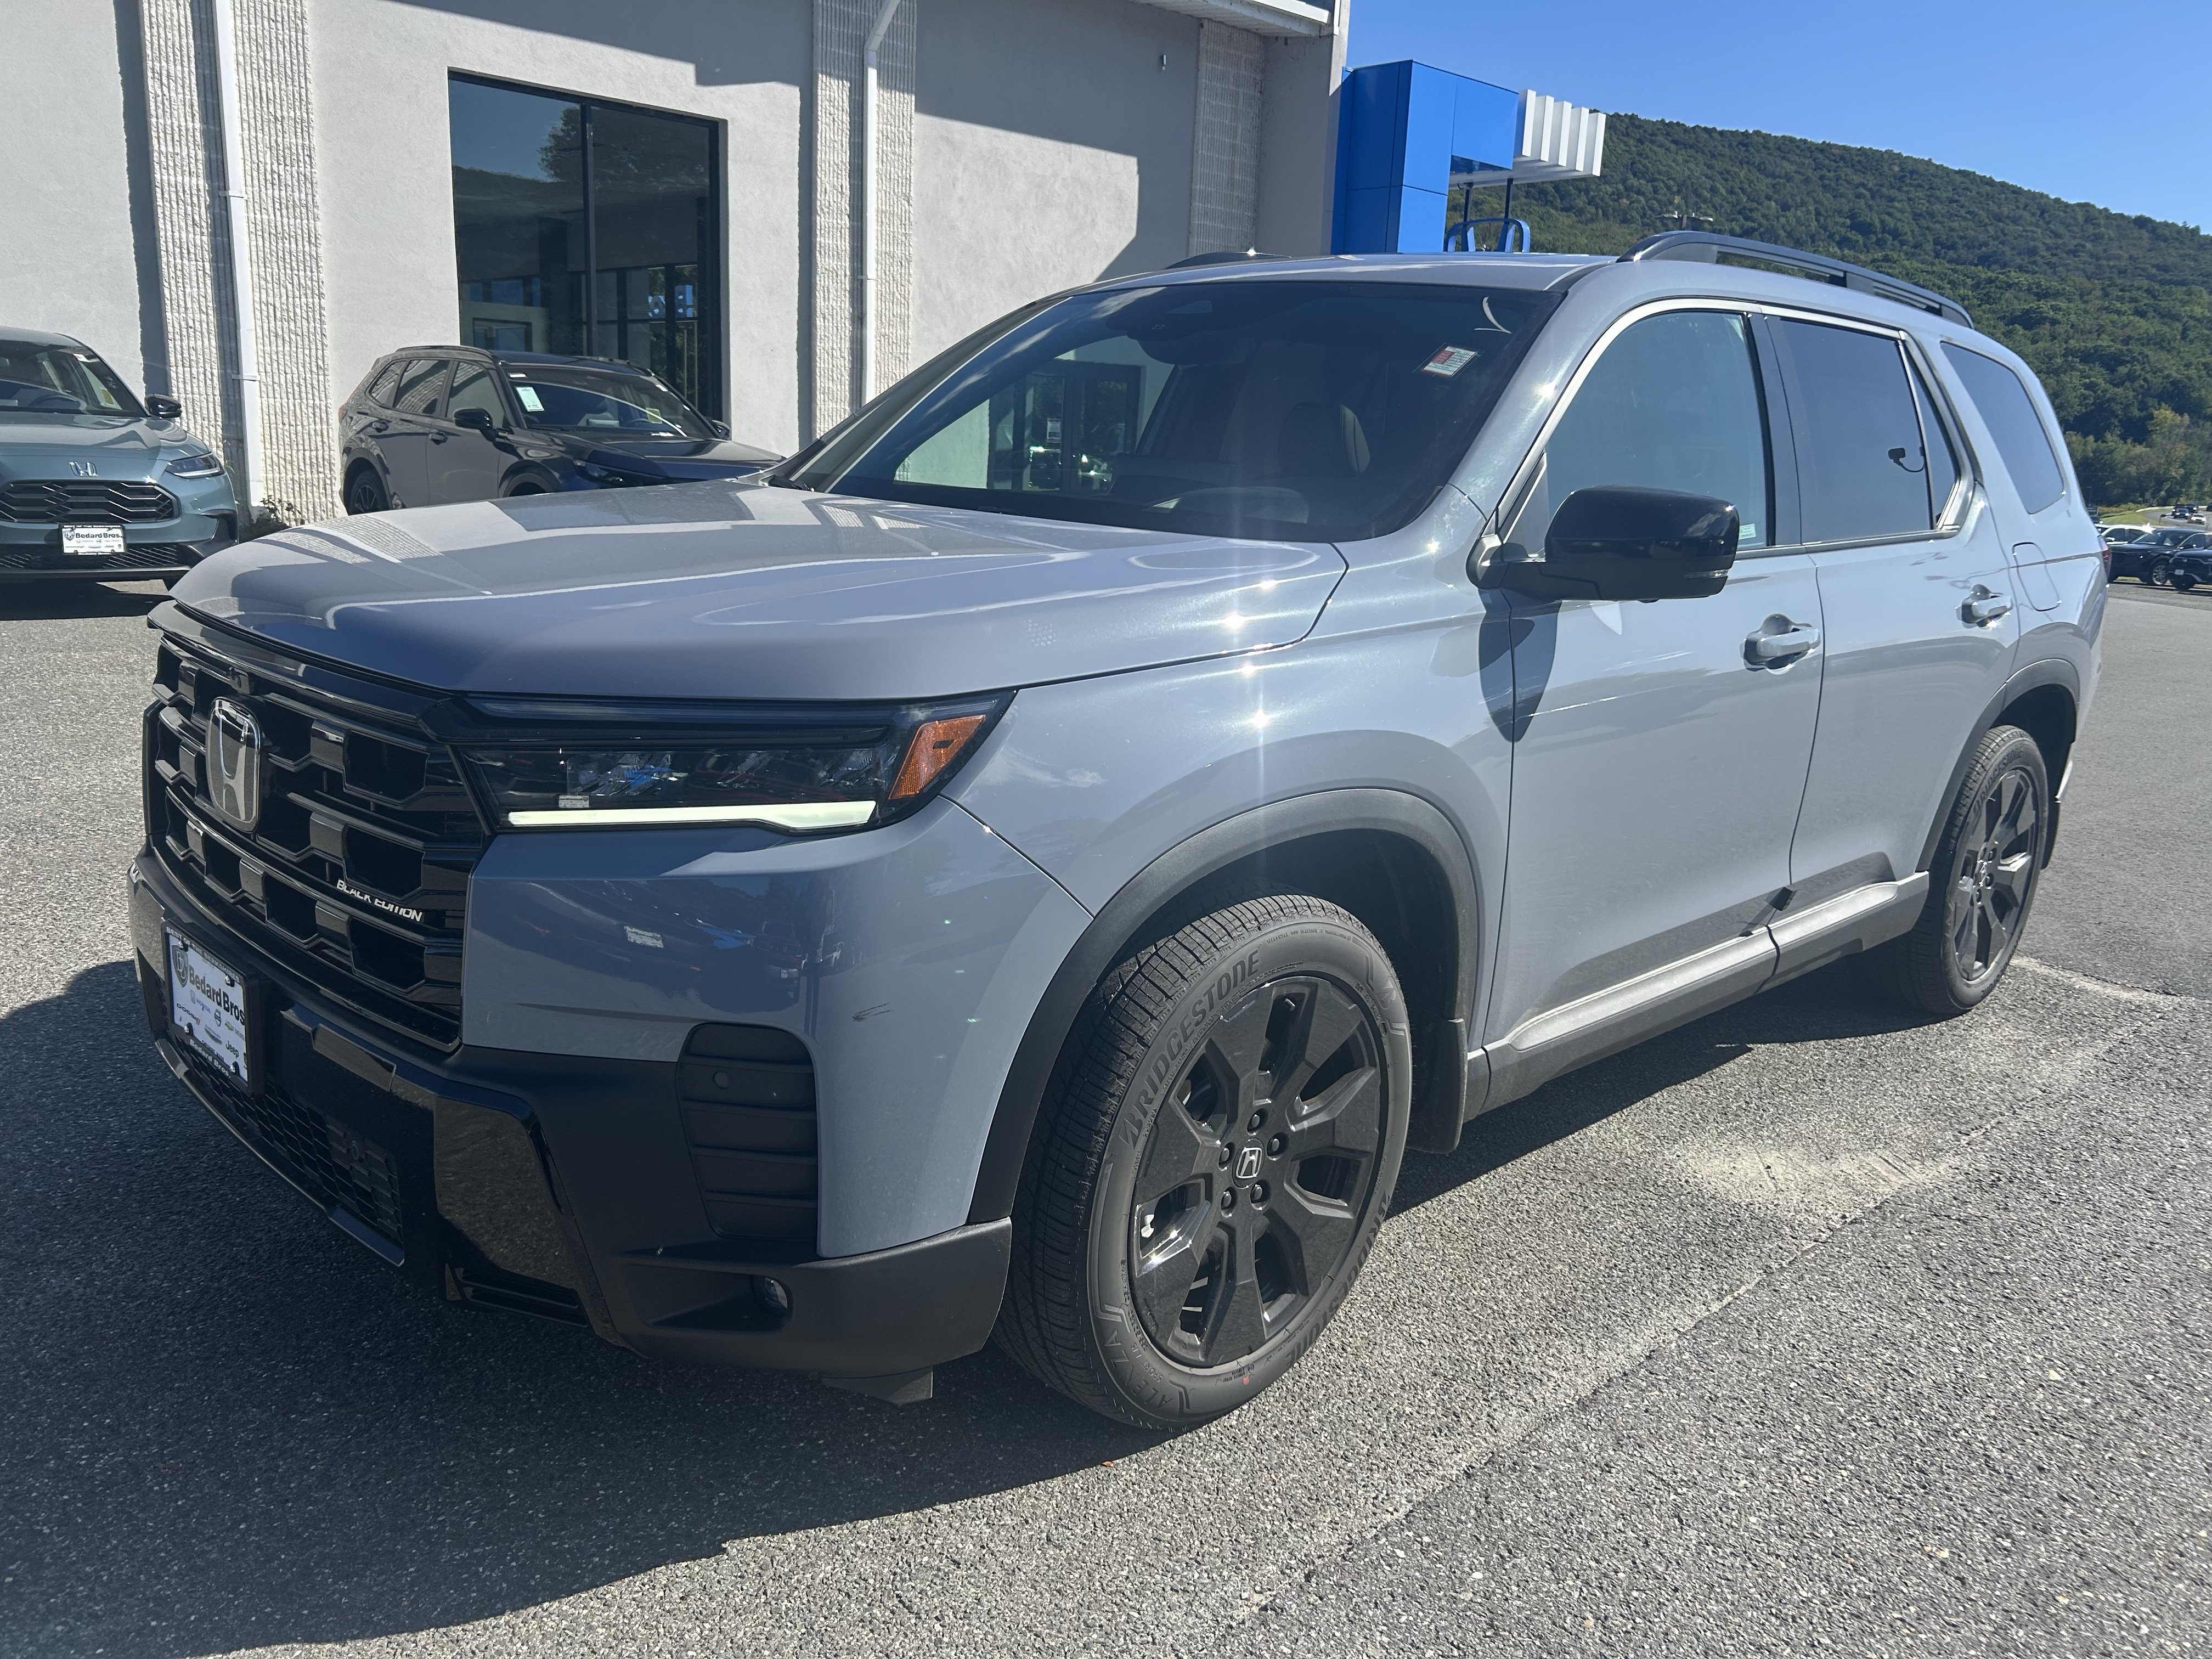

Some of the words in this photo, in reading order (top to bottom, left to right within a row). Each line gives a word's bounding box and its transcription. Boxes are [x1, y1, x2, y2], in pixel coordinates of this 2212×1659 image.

[336, 879, 372, 904] BLACK
[374, 898, 422, 922] EDITION
[166, 926, 182, 940] BEST
[189, 964, 222, 1008] Bedard
[190, 1039, 212, 1062] Bedard
[214, 1058, 232, 1079] Bros.
[225, 1040, 239, 1059] Jeep
[1119, 950, 1261, 1149] BRIDGESTONE
[1141, 1359, 1164, 1383] SPORT
